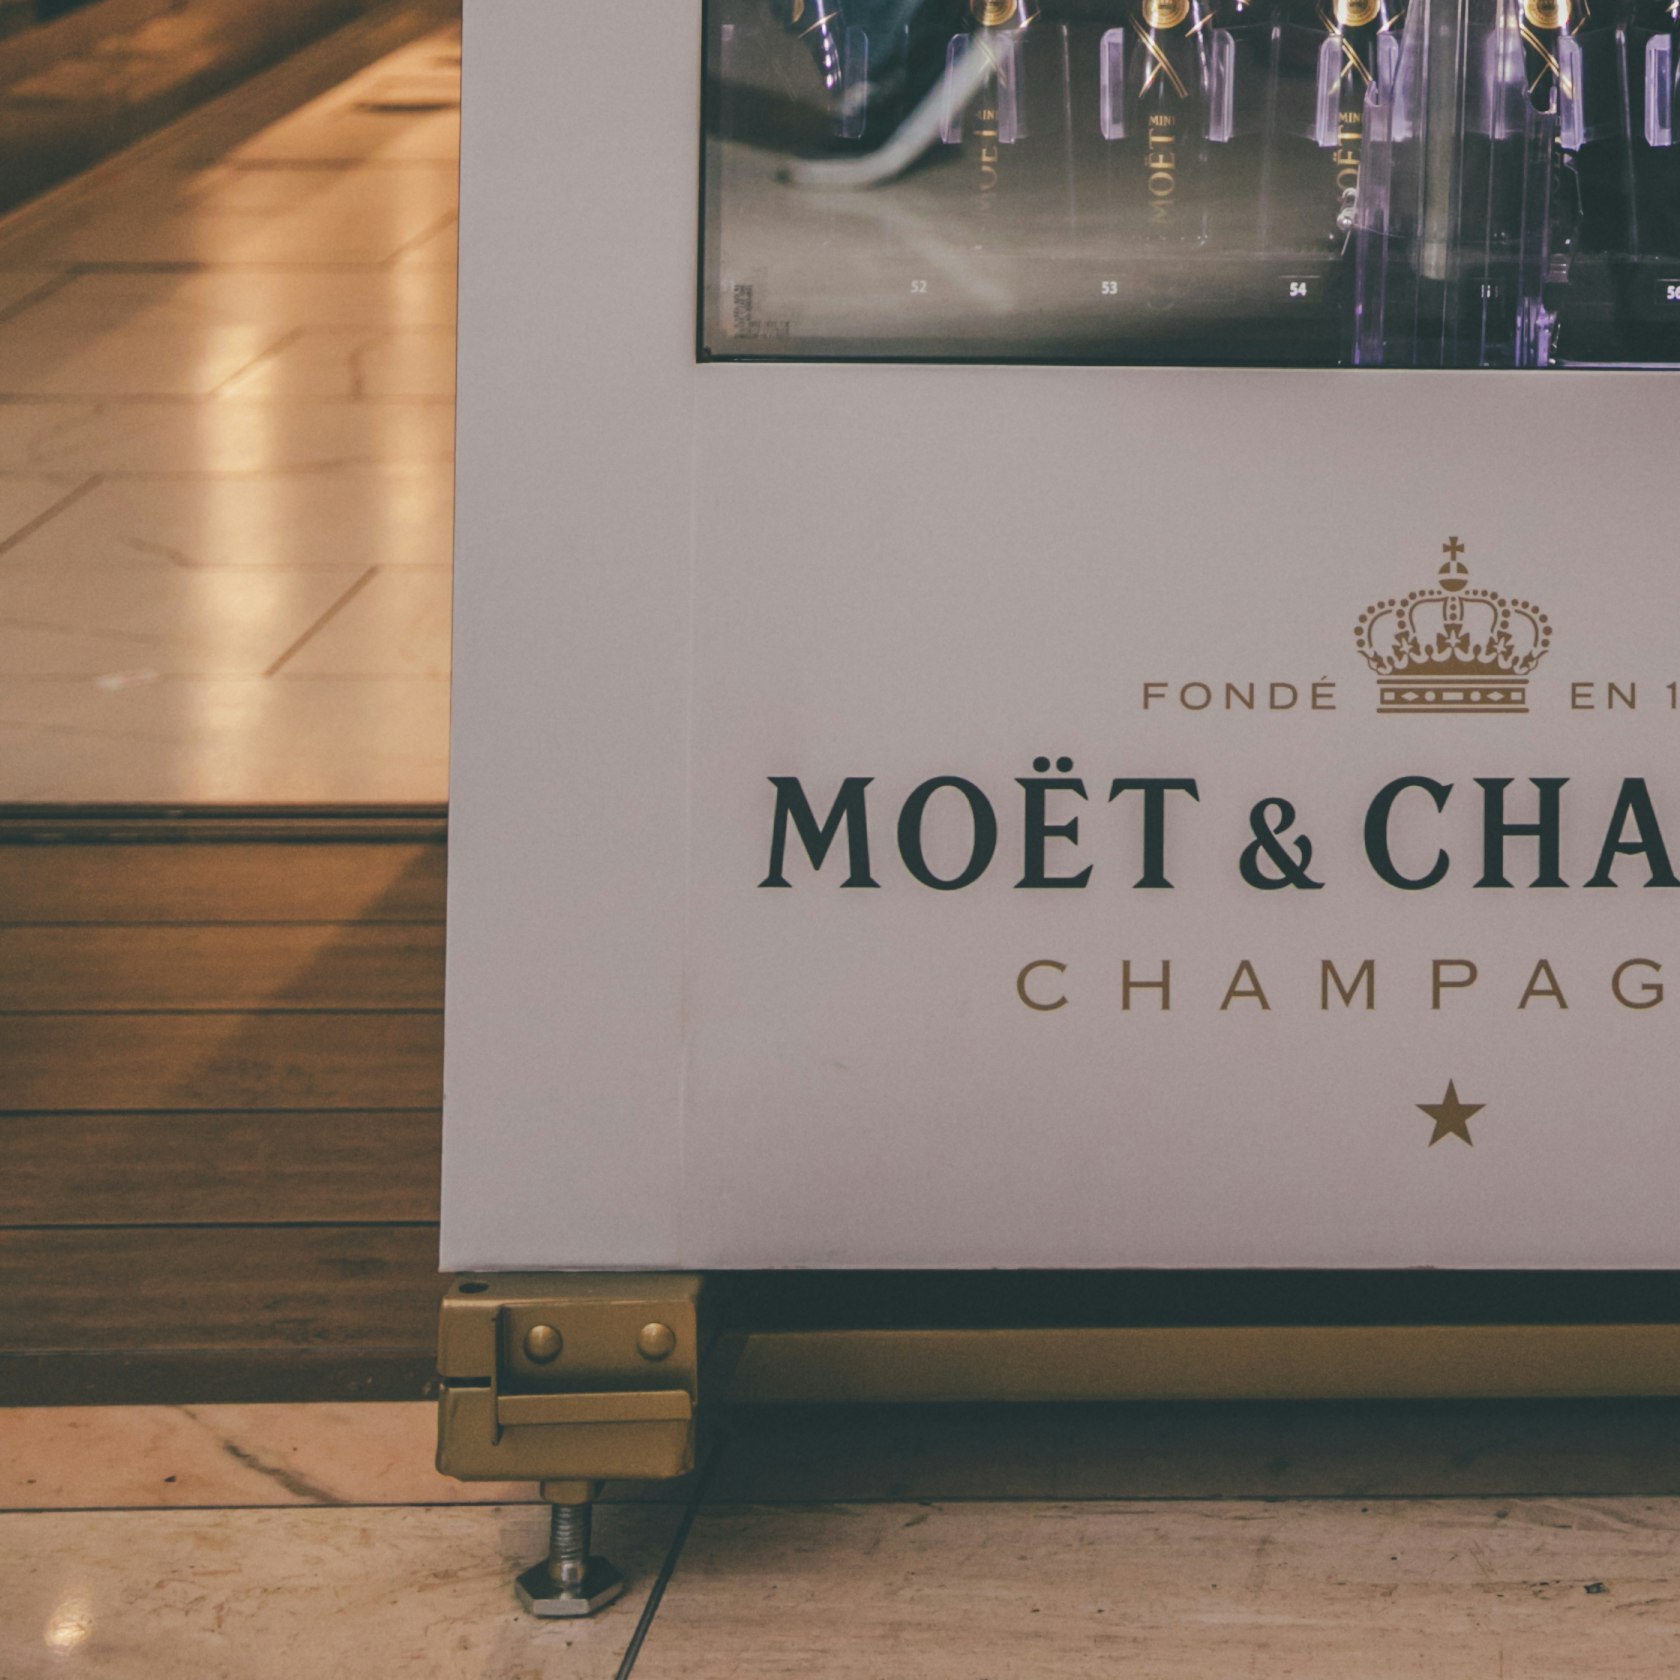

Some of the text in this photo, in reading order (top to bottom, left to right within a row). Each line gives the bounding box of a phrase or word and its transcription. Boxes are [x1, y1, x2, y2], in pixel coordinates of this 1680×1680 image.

[910, 279, 928, 294] 52
[1101, 280, 1118, 295] 53
[1288, 282, 1307, 298] 54
[1142, 675, 1338, 711] FONDÉ
[1570, 682, 1638, 710] EN
[757, 756, 1201, 891] MOËT
[1238, 796, 1326, 891] &
